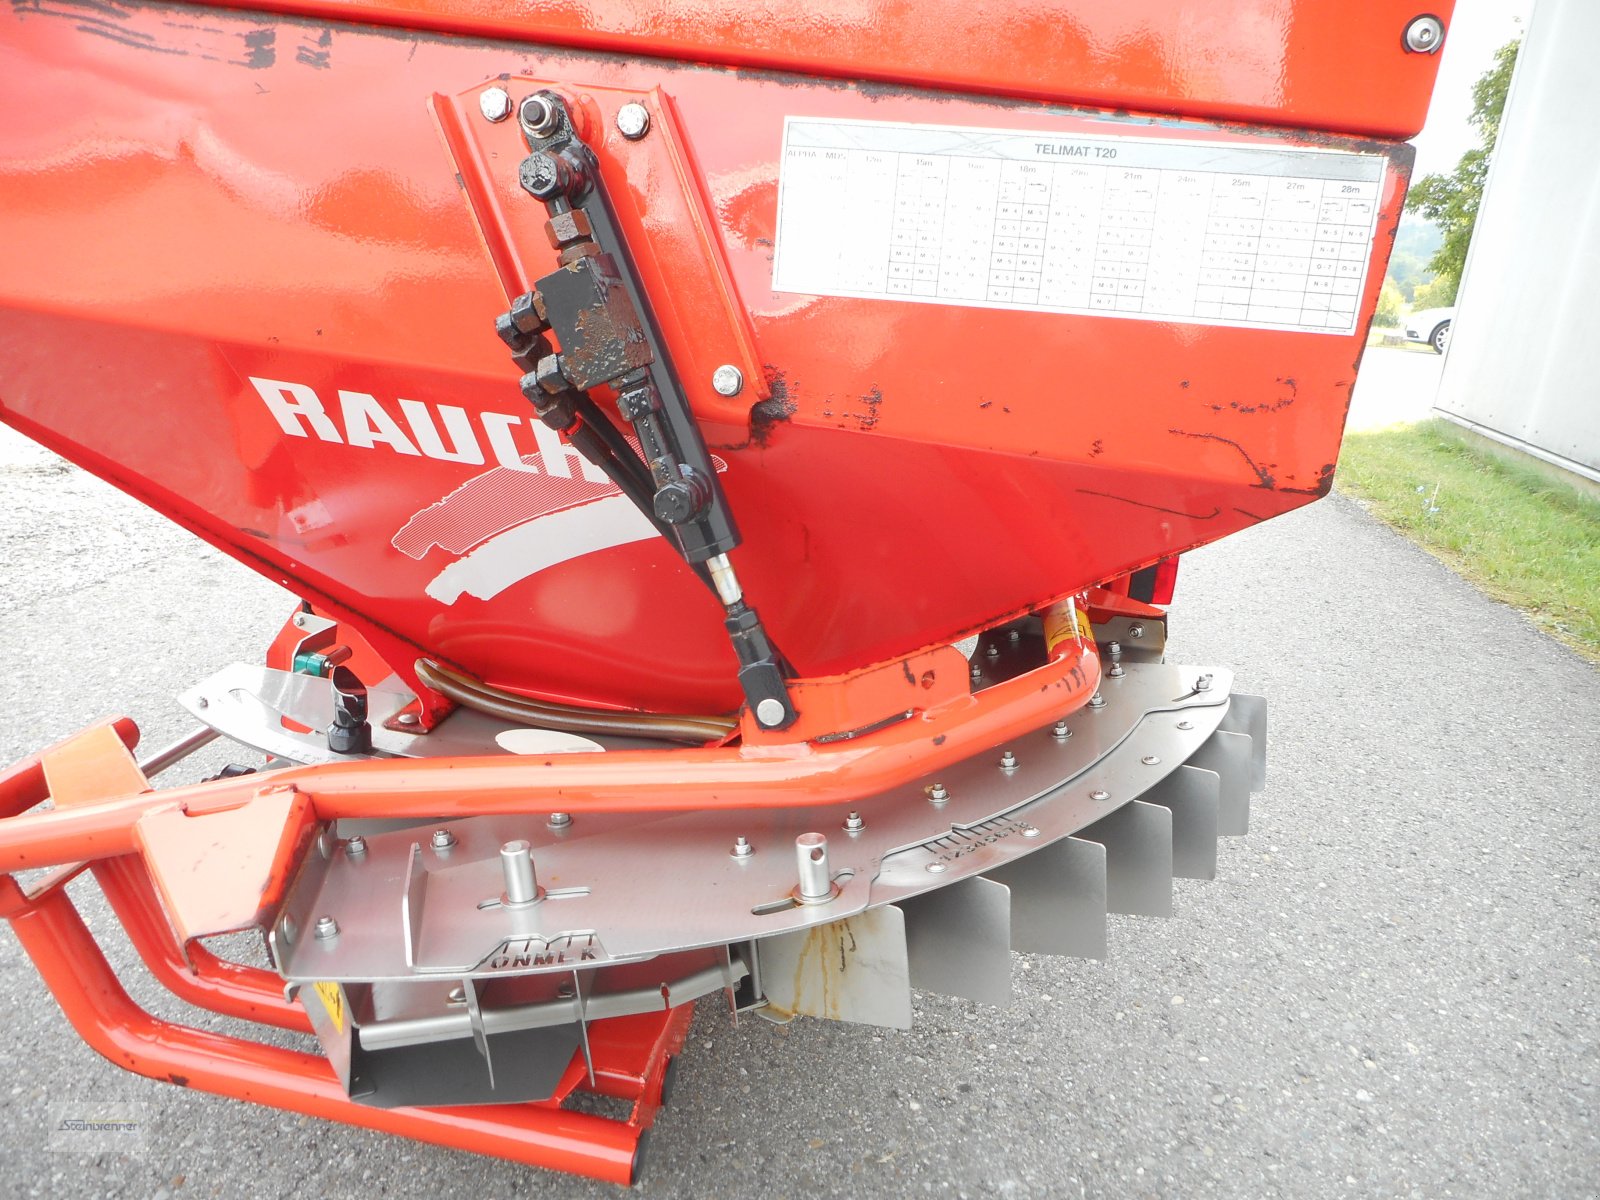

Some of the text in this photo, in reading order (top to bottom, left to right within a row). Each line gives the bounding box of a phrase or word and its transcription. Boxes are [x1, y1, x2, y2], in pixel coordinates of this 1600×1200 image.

[1035, 143, 1118, 159] TELIMAT T20
[1123, 172, 1143, 180] 21m
[1231, 178, 1251, 187] 25m
[1286, 182, 1305, 191] 27m
[1341, 185, 1361, 194] 28m
[249, 376, 610, 484] RAUCH
